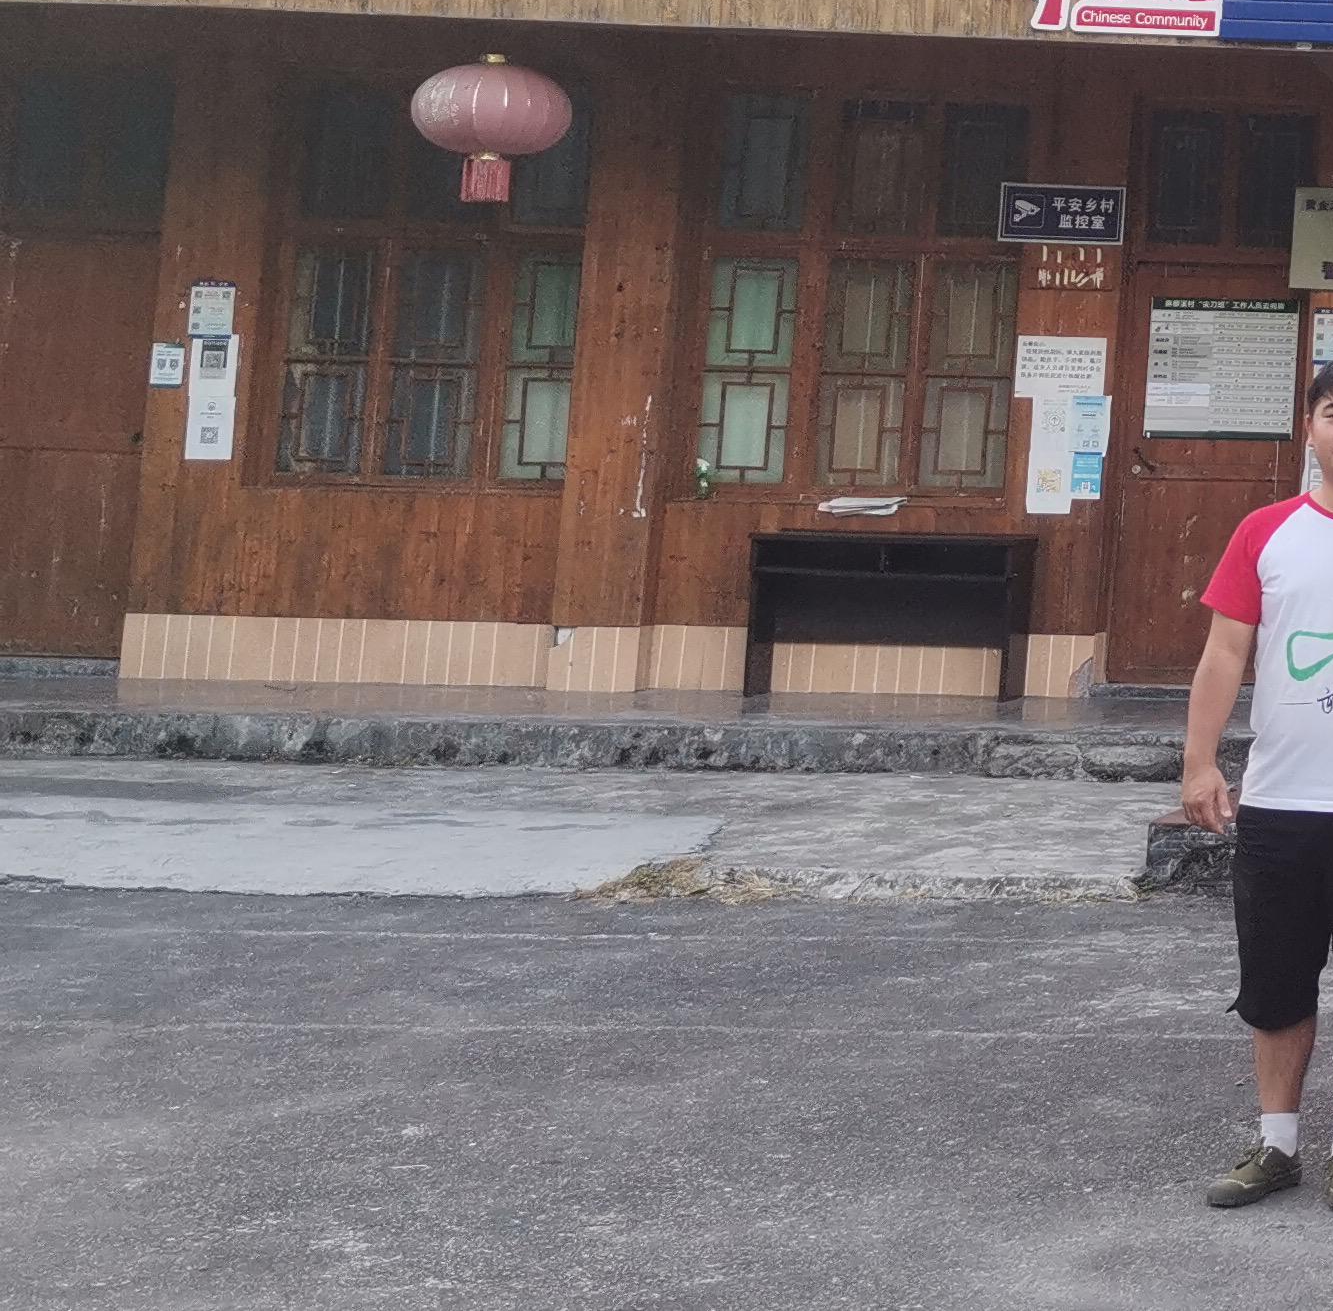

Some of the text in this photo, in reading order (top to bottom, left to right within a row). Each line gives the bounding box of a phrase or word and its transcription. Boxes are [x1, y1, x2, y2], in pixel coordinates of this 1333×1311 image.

[1081, 9, 1208, 29] Chinese Community
[1051, 196, 1115, 213] 平安乡村
[1058, 214, 1106, 229] 监控室
